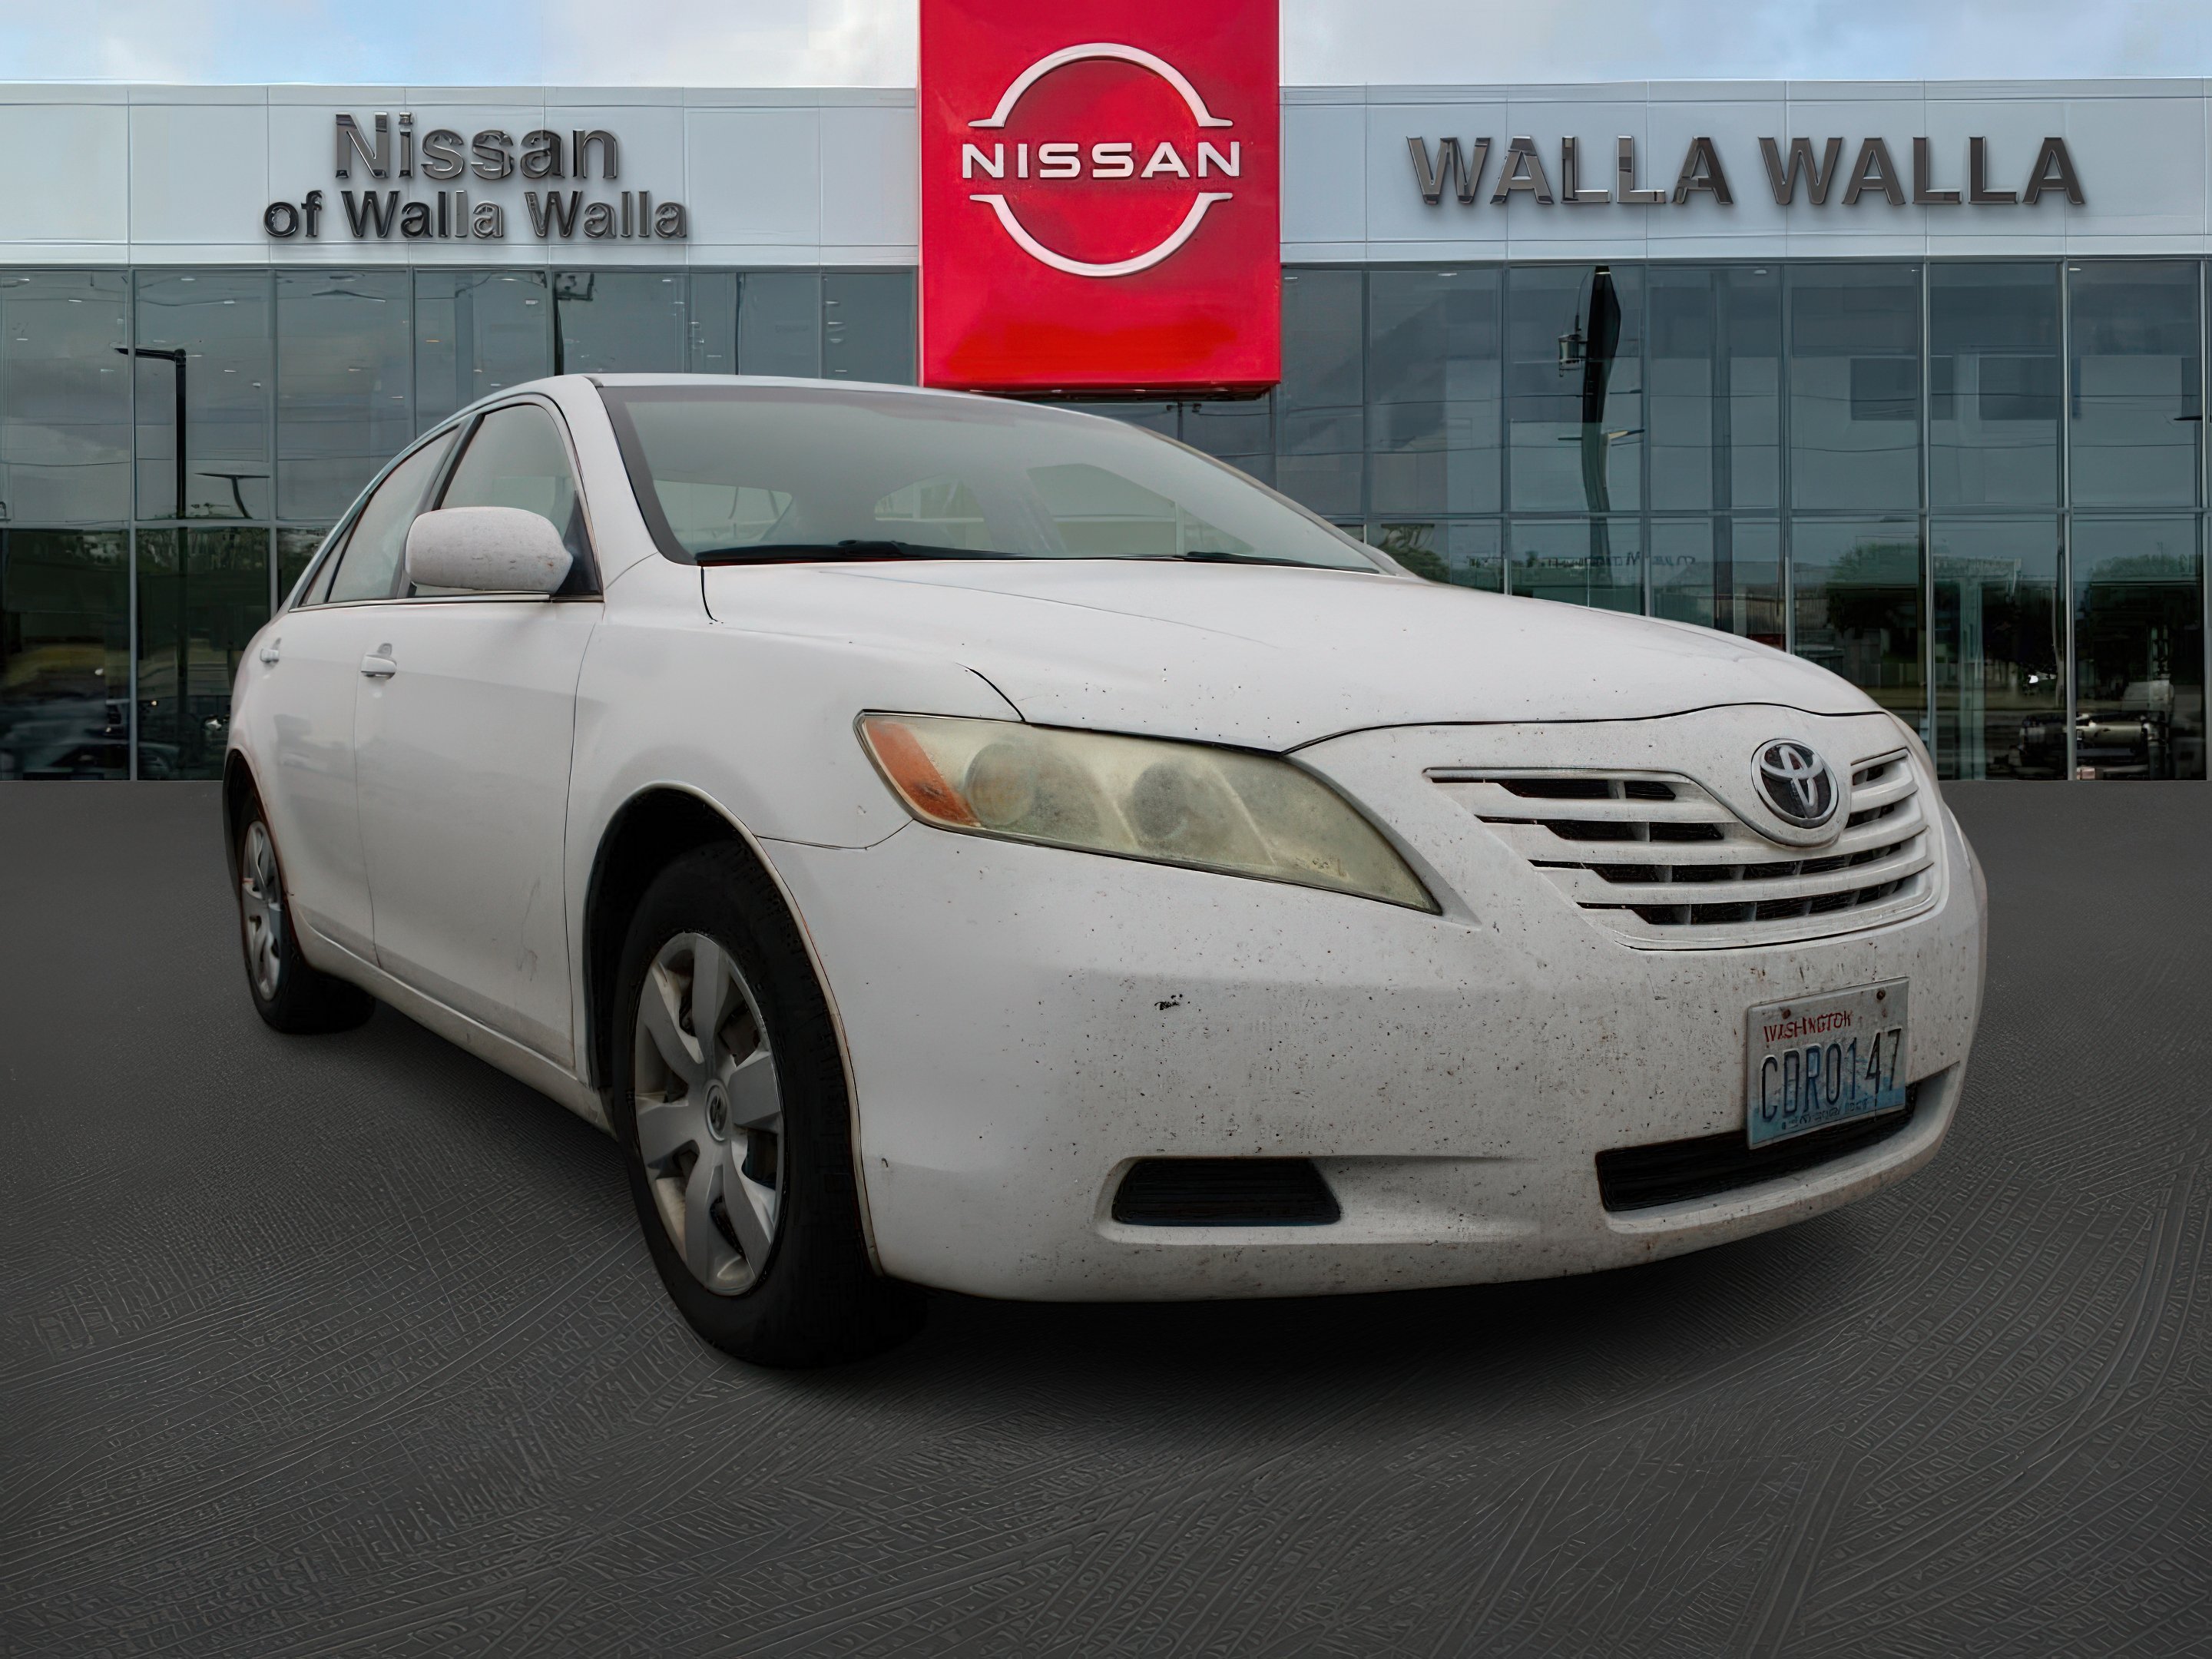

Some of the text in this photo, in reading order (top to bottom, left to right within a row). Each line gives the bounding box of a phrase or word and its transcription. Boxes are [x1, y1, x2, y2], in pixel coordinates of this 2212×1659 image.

[334, 111, 619, 180] Nissan
[962, 141, 1240, 179] NISSAN
[1406, 134, 2086, 206] WALLA WALLA
[263, 190, 687, 239] of Walla Walla
